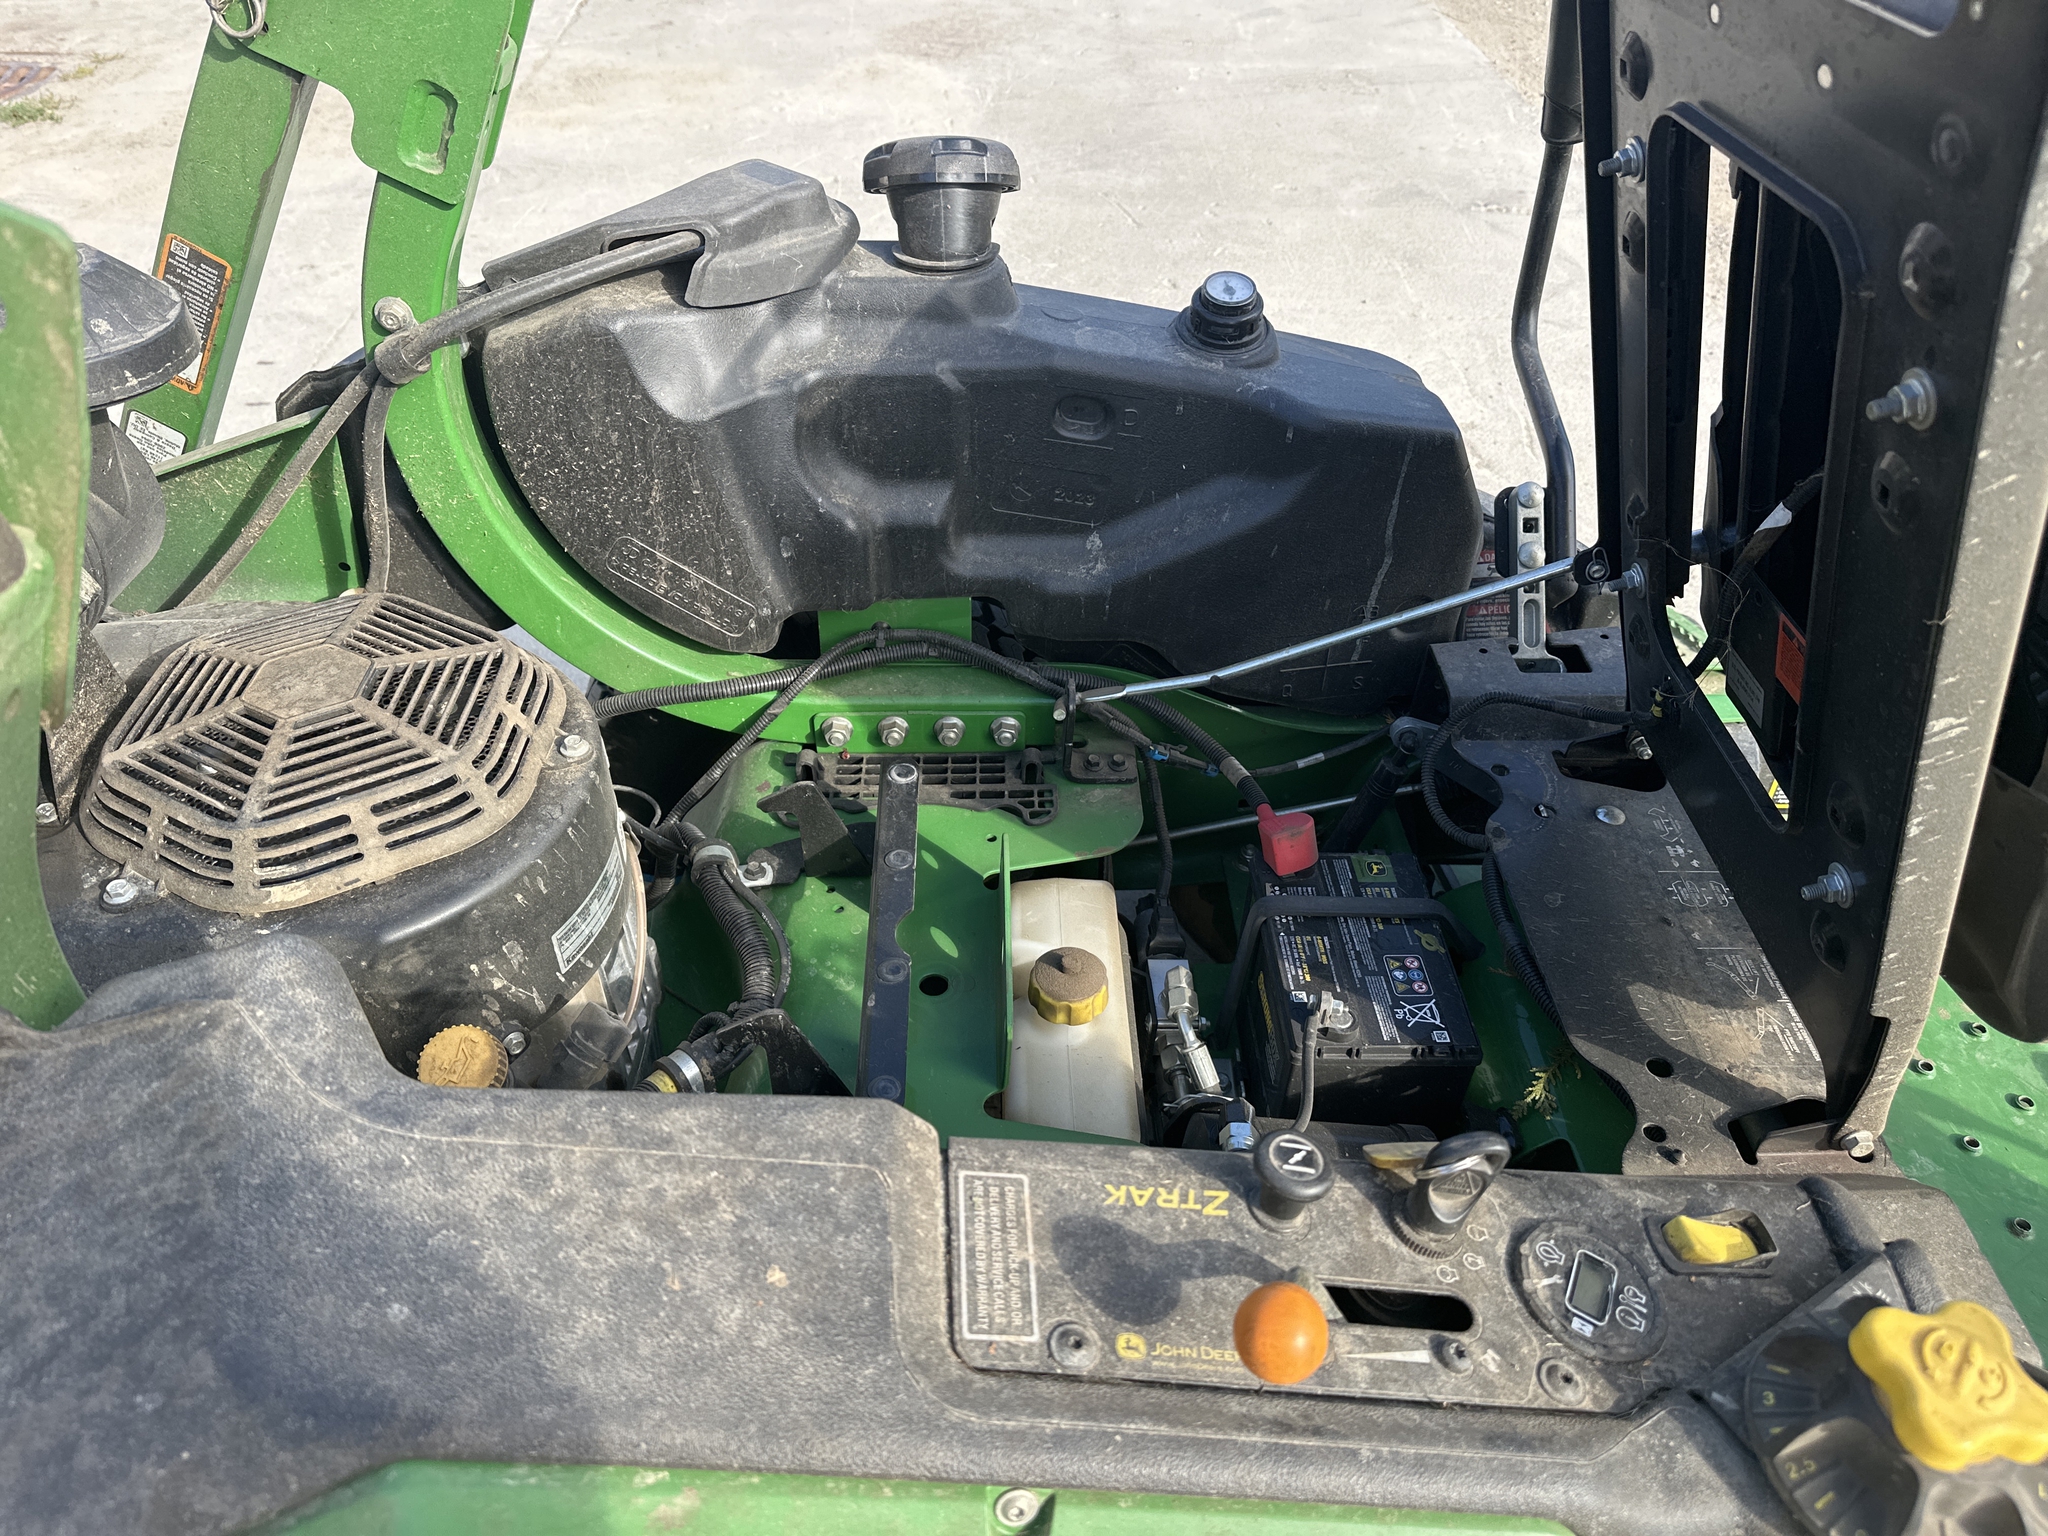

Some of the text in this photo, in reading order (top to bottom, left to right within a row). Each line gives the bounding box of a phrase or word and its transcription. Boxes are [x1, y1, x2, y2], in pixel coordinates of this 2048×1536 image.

[1395, 1008, 1405, 1020] Pb
[1004, 1186, 1017, 1227] CHARGES
[1103, 1184, 1230, 1216] ZTRAK
[1006, 1229, 1017, 1246] FOR
[973, 1180, 989, 1330] ARE NOT COVERED BY WARRANTY
[989, 1186, 1006, 1323] DELIVERY AND SERVICE CALLS
[1008, 1248, 1020, 1286] PICK-UP
[1150, 1342, 1198, 1358] JOHN
[1762, 1391, 1775, 1406] 3
[1785, 1459, 1817, 1480] 2.5
